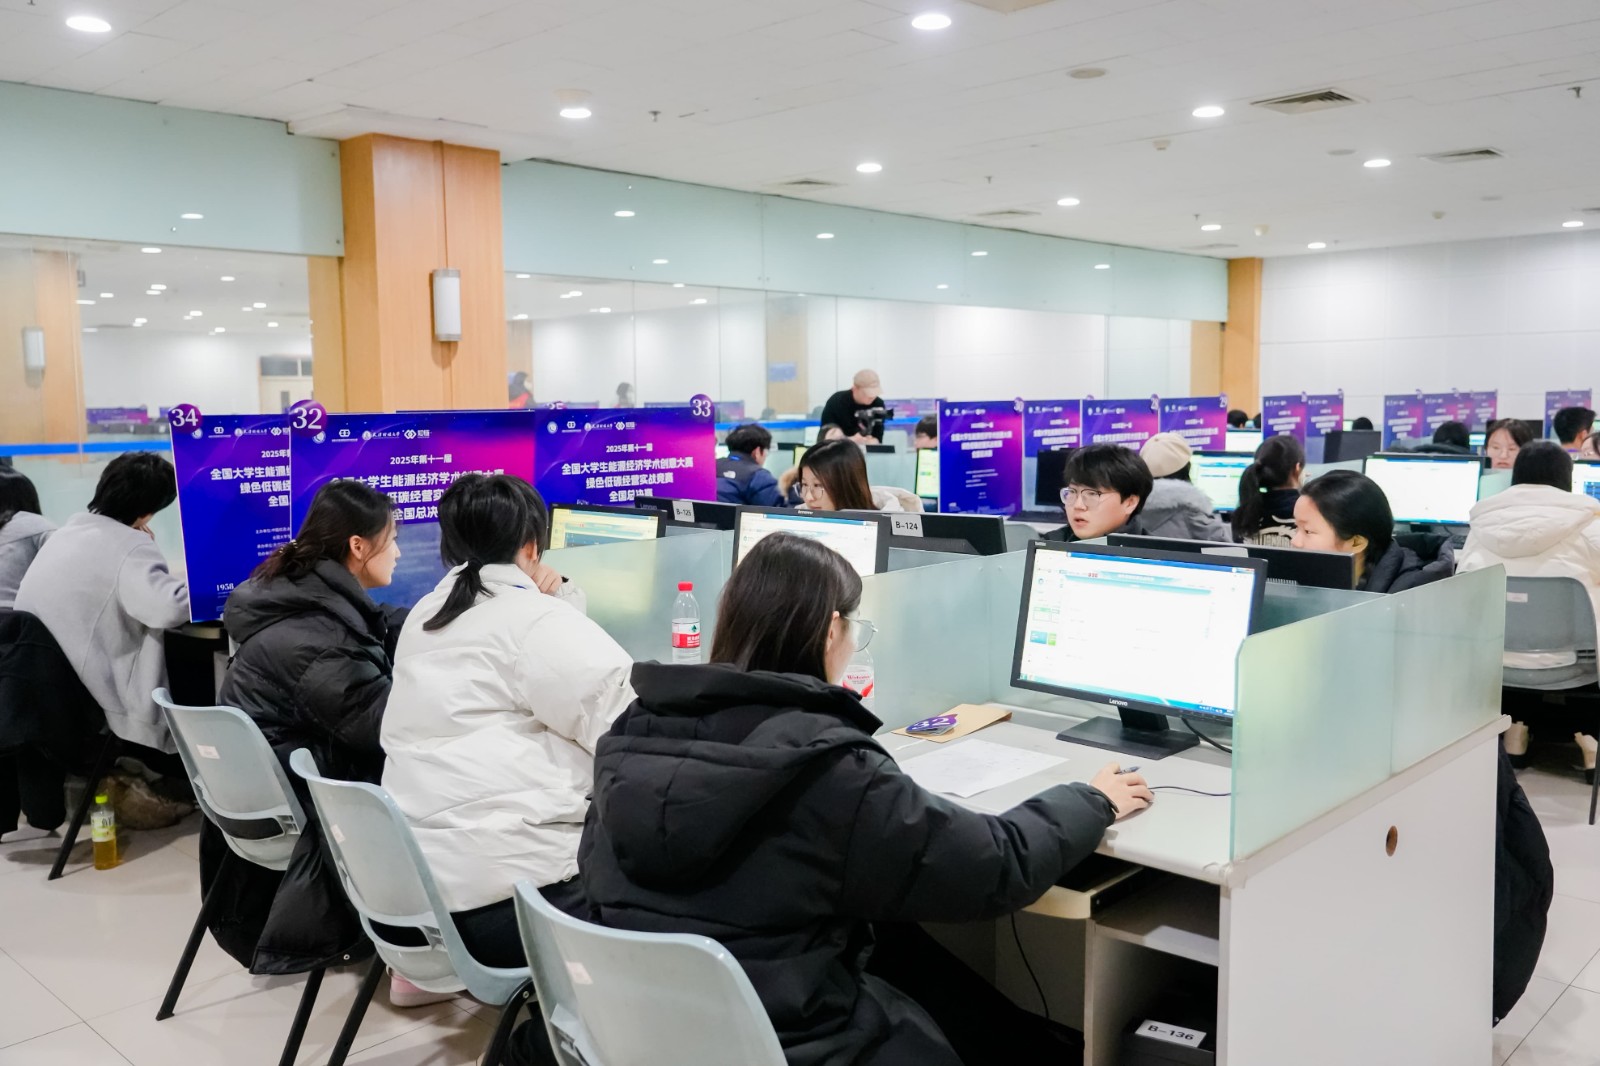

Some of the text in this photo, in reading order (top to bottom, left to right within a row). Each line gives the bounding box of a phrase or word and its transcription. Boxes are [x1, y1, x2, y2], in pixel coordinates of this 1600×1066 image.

[692, 399, 711, 417] 33
[172, 408, 199, 427] 34
[292, 407, 322, 430] 32
[389, 453, 452, 465] 2025年第十一届
[675, 508, 692, 518] B-125
[895, 520, 918, 531] B-124
[216, 583, 234, 592] 1958
[1108, 698, 1128, 707] Lenovo
[1147, 1024, 1195, 1041] B-136
